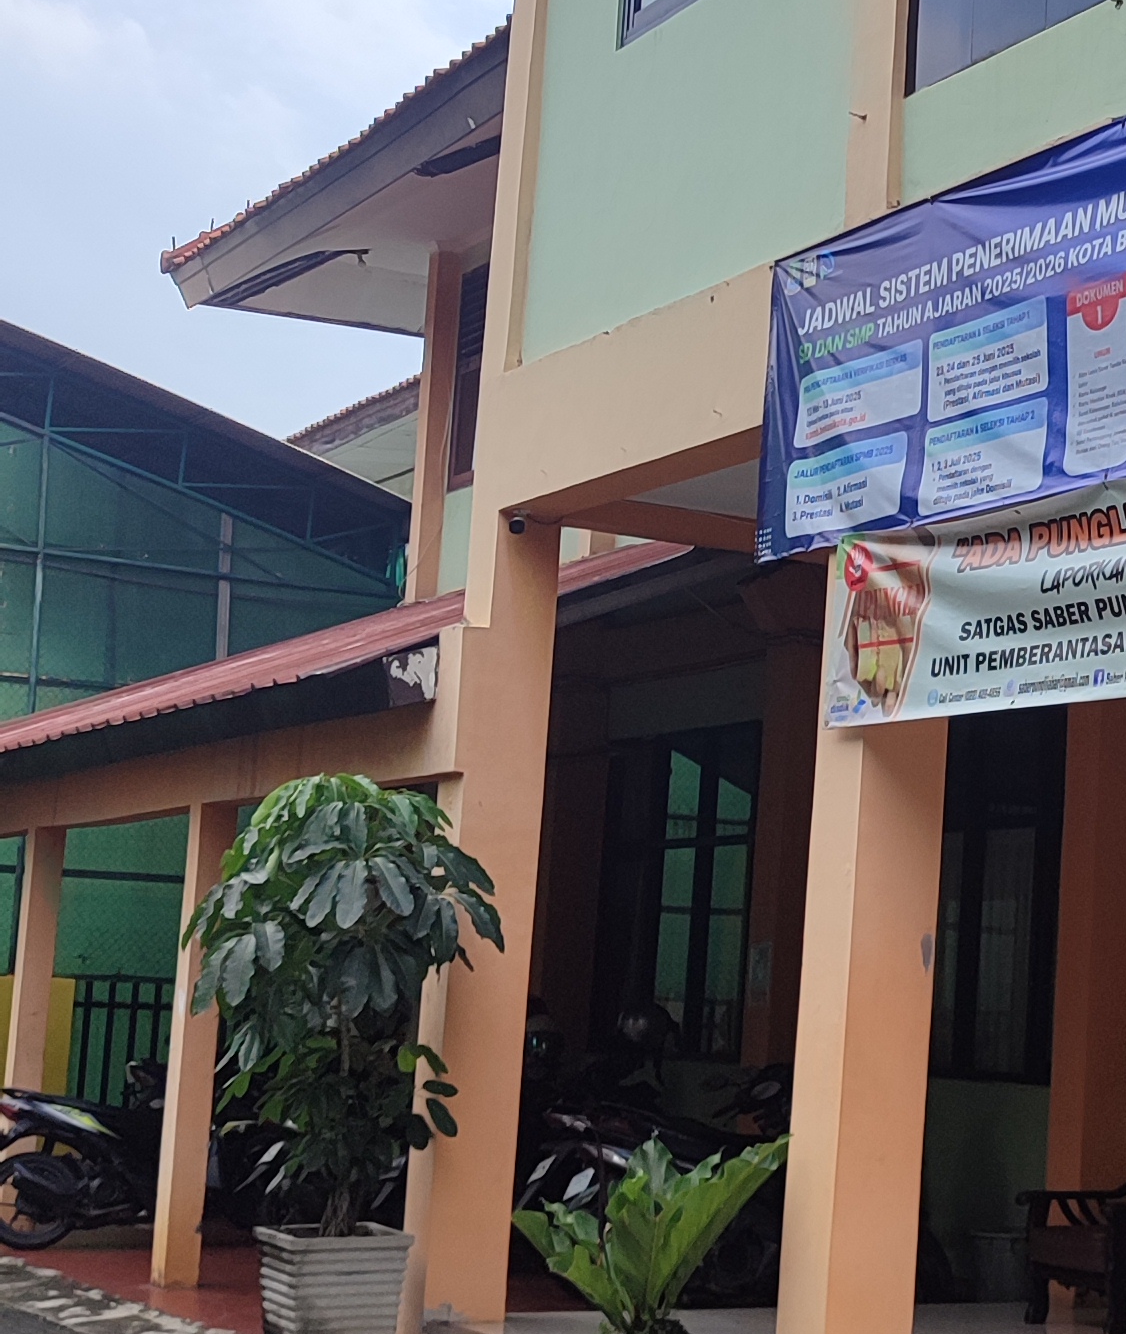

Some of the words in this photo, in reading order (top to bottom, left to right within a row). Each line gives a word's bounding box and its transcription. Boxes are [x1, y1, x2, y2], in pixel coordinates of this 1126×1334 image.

[797, 287, 876, 336] JADWAL
[879, 256, 948, 310] SISTEM
[952, 204, 1095, 283] PENERIMAAN
[799, 342, 813, 365] SD
[815, 334, 844, 358] DAN
[846, 322, 875, 349] SMP
[877, 303, 922, 338] TAHUN
[924, 285, 982, 322] AJARAN
[984, 254, 1065, 300] 2025/2026
[1067, 235, 1111, 271] KOTA
[1076, 279, 1124, 308] DOKUMEN
[1096, 305, 1103, 325] 1
[956, 358, 970, 370] dan
[971, 354, 980, 367] 25
[981, 350, 996, 364] Juni
[971, 387, 1001, 400] Afirmasi
[1001, 383, 1015, 394] dan
[1015, 373, 1041, 389] Mutasi)
[829, 396, 843, 408] Juni
[979, 417, 1005, 433] SELEKSI
[1006, 412, 1030, 427] TAHAP
[800, 506, 834, 520] Prestasi
[958, 612, 1028, 642] SATGAS
[1031, 601, 1092, 631] SABER
[930, 653, 970, 678] UNIT
[1105, 671, 1123, 685] Saber
